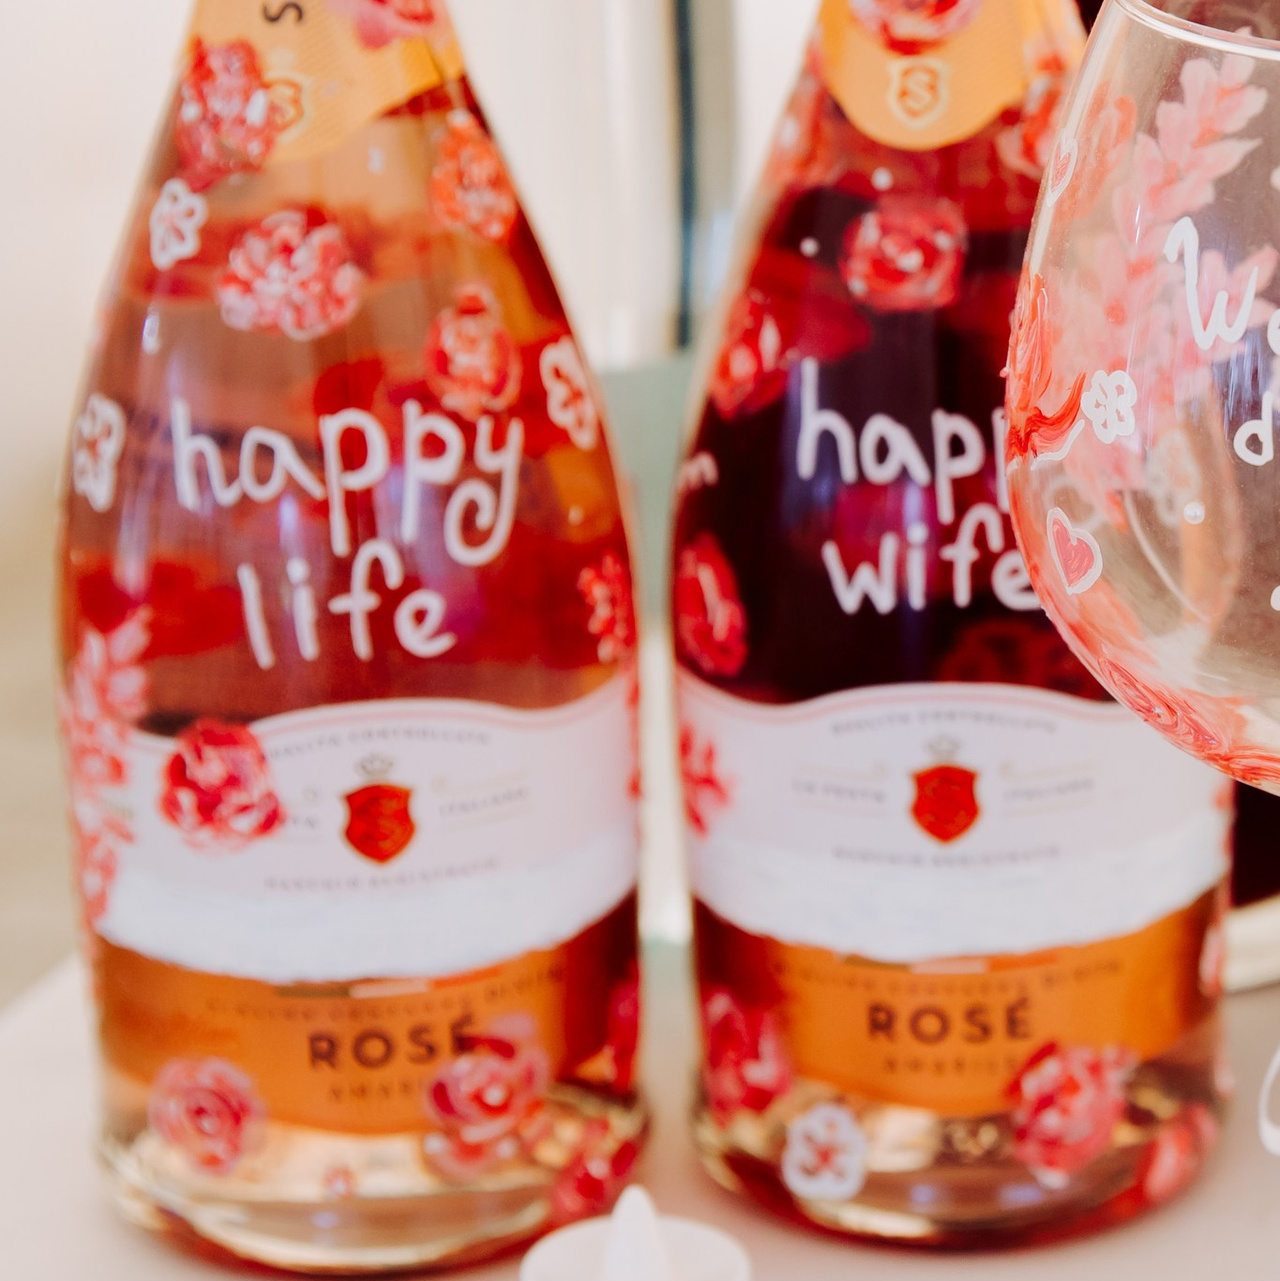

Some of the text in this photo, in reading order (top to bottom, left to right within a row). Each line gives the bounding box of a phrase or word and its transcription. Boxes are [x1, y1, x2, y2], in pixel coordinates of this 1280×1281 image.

[170, 398, 523, 566] happy
[238, 538, 457, 671] life
[822, 503, 1043, 615] wife
[866, 996, 1036, 1046] ROSÉ
